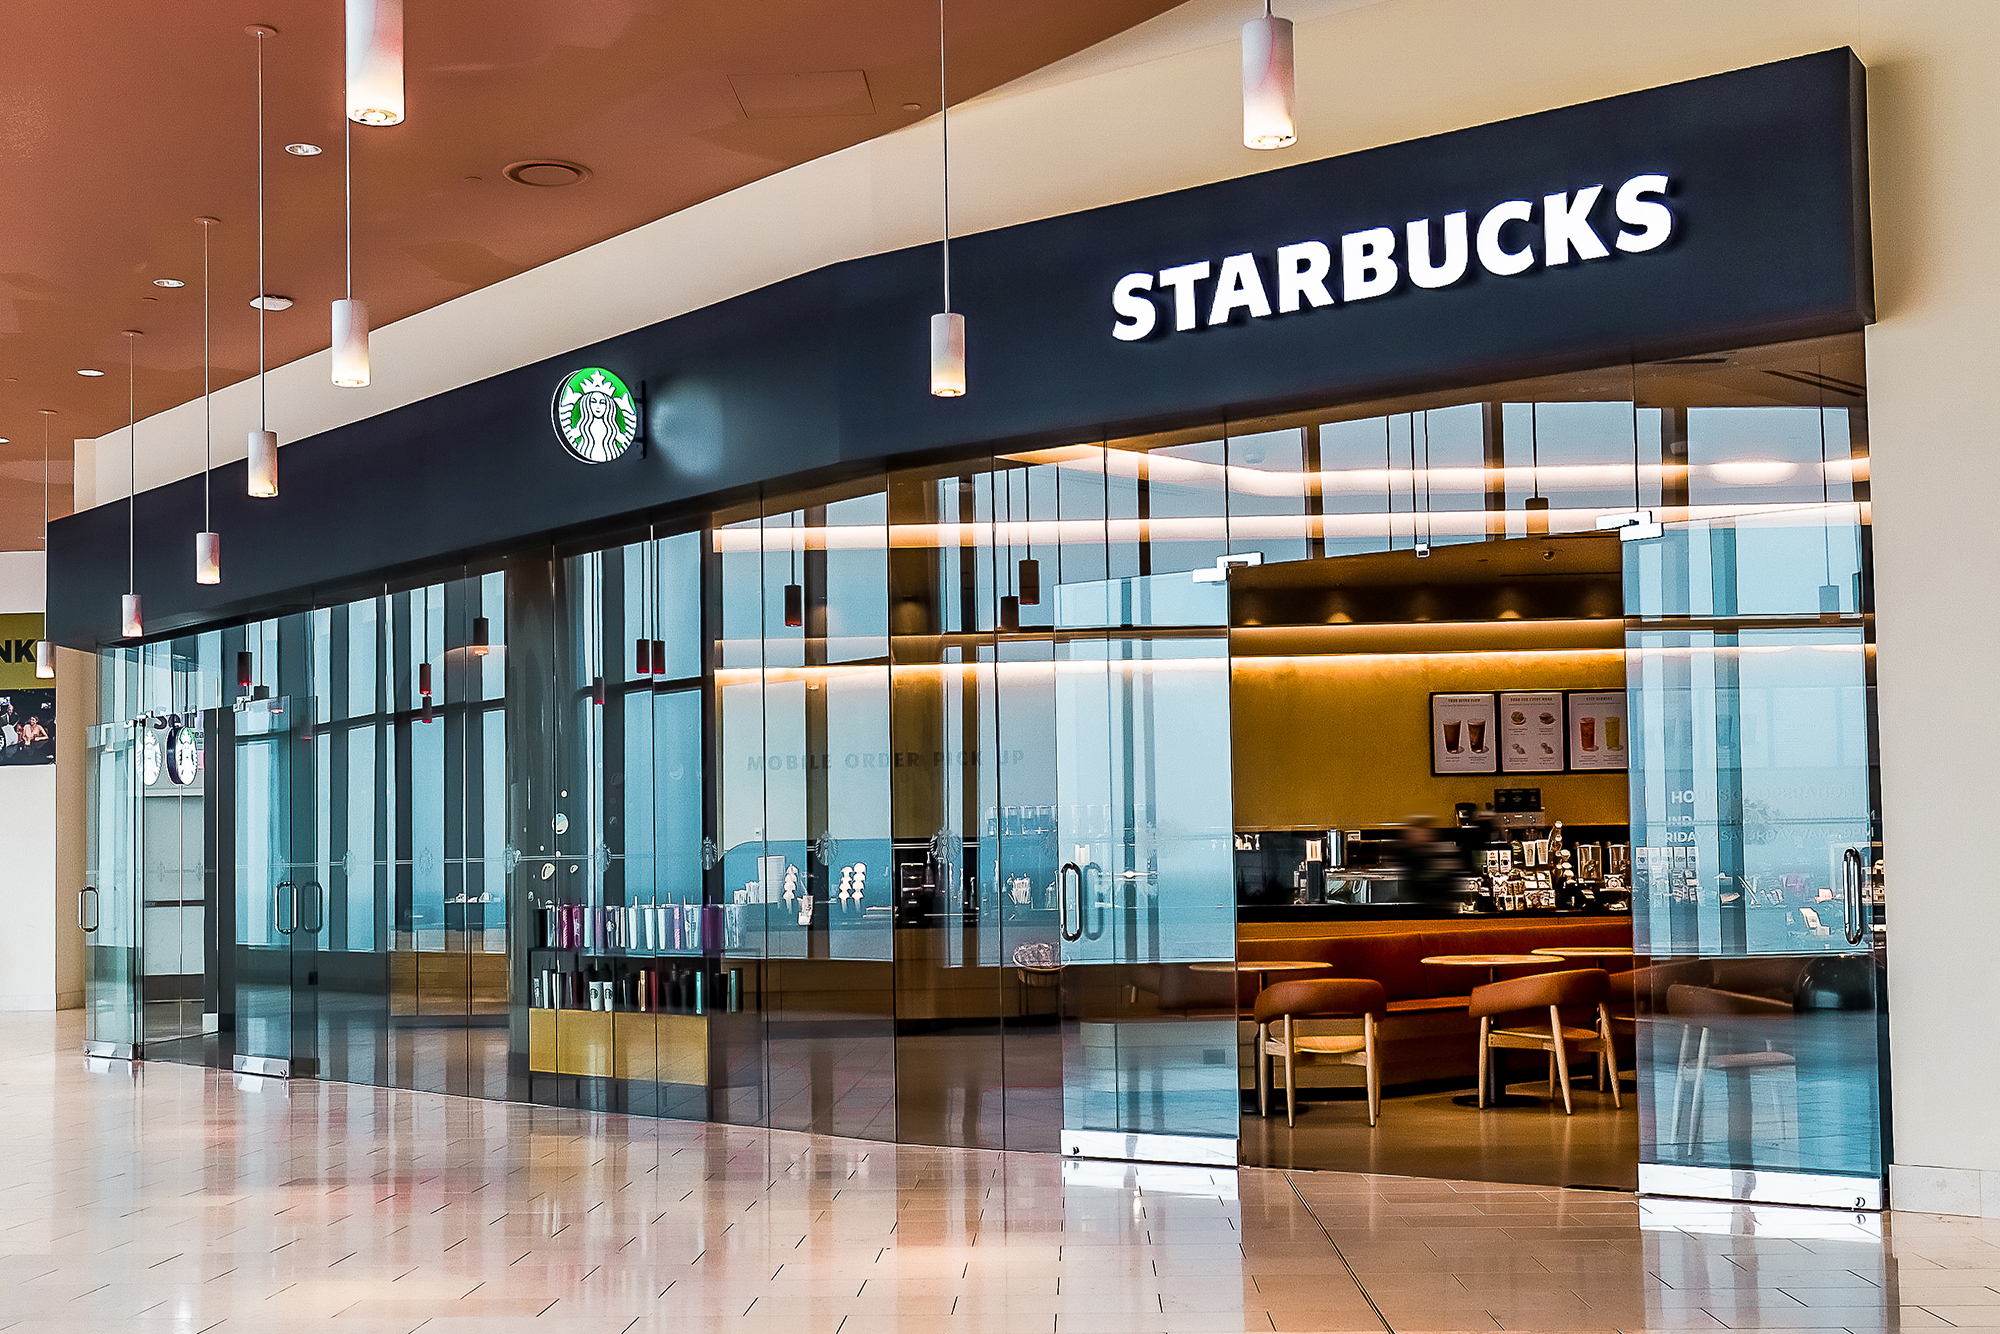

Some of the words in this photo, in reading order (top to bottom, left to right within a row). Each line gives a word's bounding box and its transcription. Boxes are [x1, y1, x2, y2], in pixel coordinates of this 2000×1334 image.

[1112, 173, 1672, 341] STARBUCKS
[747, 754, 831, 771] MOBILE
[845, 751, 920, 769] ORDER
[933, 751, 984, 767] PICK
[1000, 750, 1024, 765] UP
